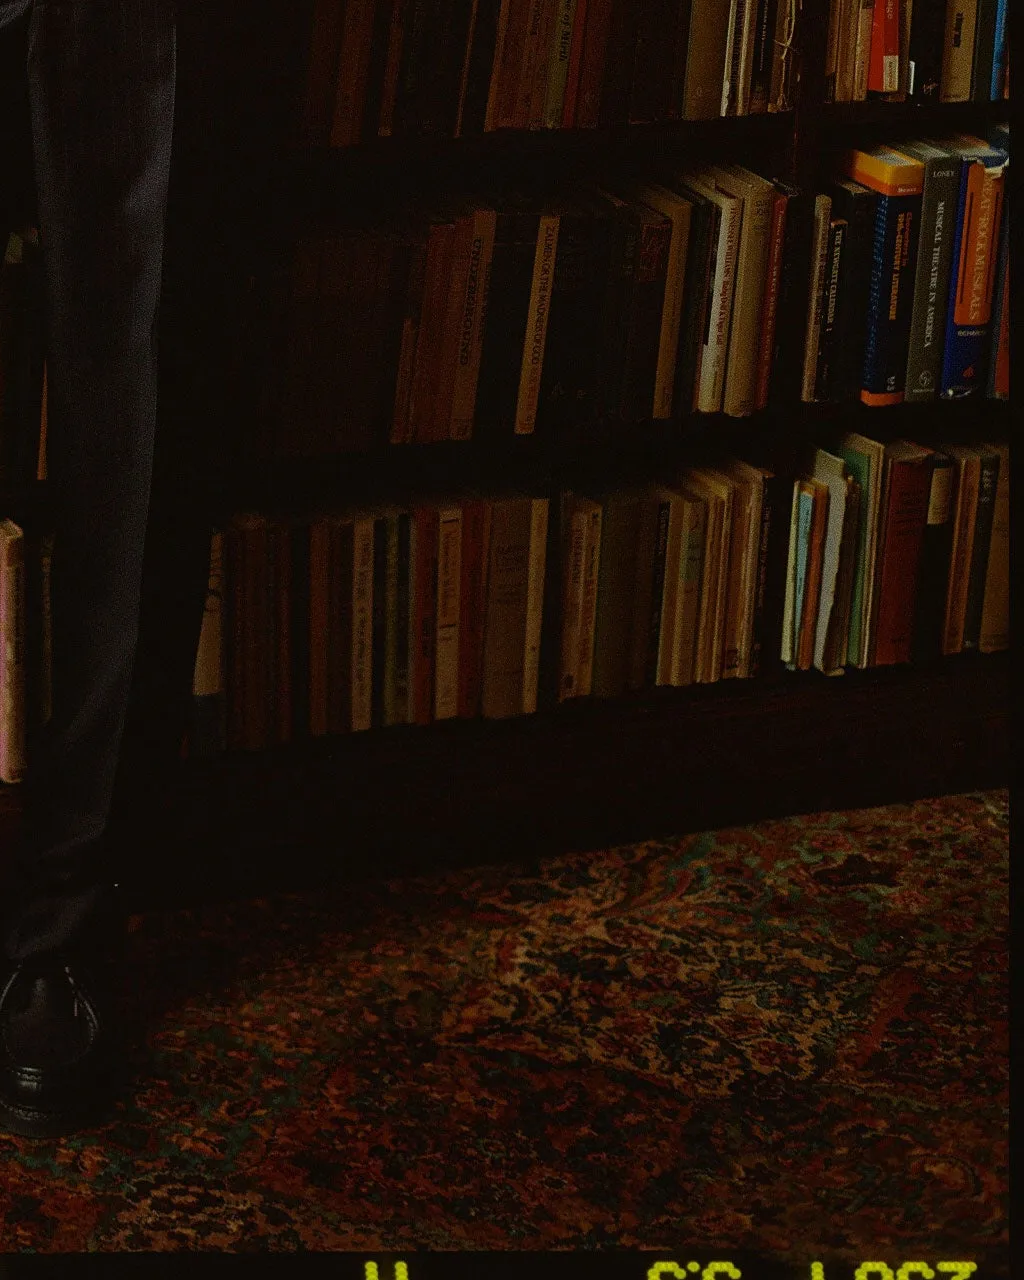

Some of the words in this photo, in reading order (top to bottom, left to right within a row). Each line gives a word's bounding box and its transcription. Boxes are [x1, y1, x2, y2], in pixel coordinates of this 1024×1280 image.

[562, 14, 570, 26] of
[560, 31, 570, 61] Mirth
[934, 201, 945, 244] MUSICAL
[975, 219, 988, 252] ROCK
[930, 247, 941, 290] THEATRE
[969, 255, 986, 320] MUSICALS
[826, 284, 838, 324] CALENDAR
[928, 292, 936, 302] IN
[924, 306, 934, 348] AMERICA
